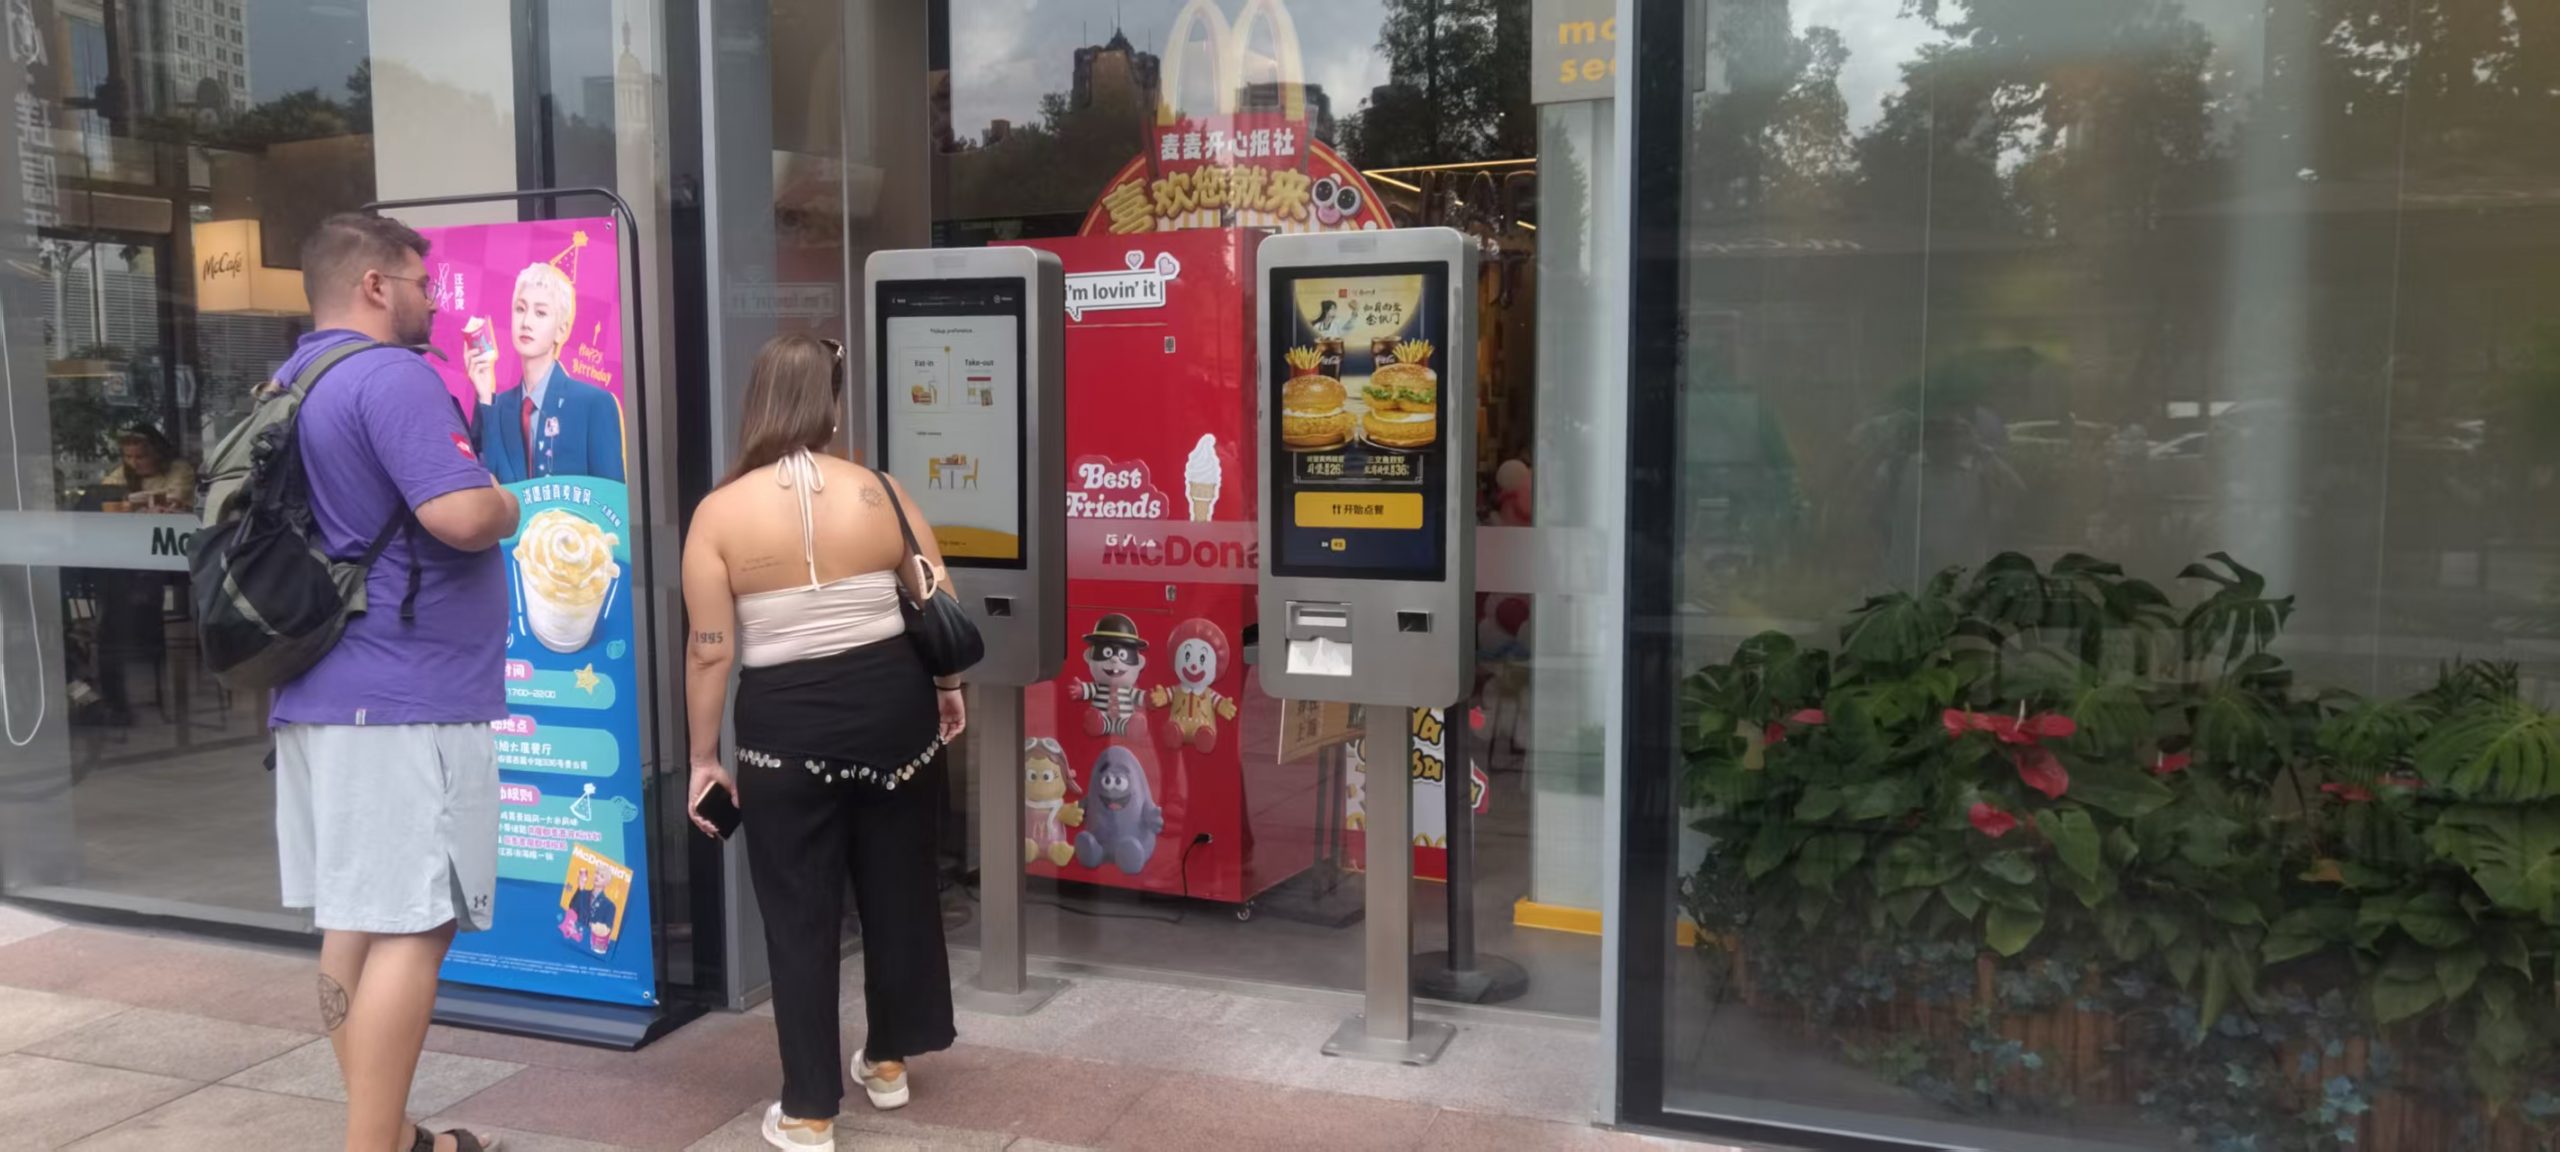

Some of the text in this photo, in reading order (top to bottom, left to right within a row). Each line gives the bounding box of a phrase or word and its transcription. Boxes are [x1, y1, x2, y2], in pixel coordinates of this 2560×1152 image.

[1559, 57, 1616, 84] se
[1160, 127, 1296, 161] 麦麦开心报社
[1102, 165, 1311, 234] 喜欢您就来
[1093, 280, 1139, 300] lovin'
[1143, 279, 1156, 298] it
[914, 359, 934, 367] Eat-in
[964, 358, 994, 367] Take-out
[1079, 463, 1142, 489] Best
[1067, 492, 1161, 518] Friends
[1343, 504, 1384, 515] 开始点餐
